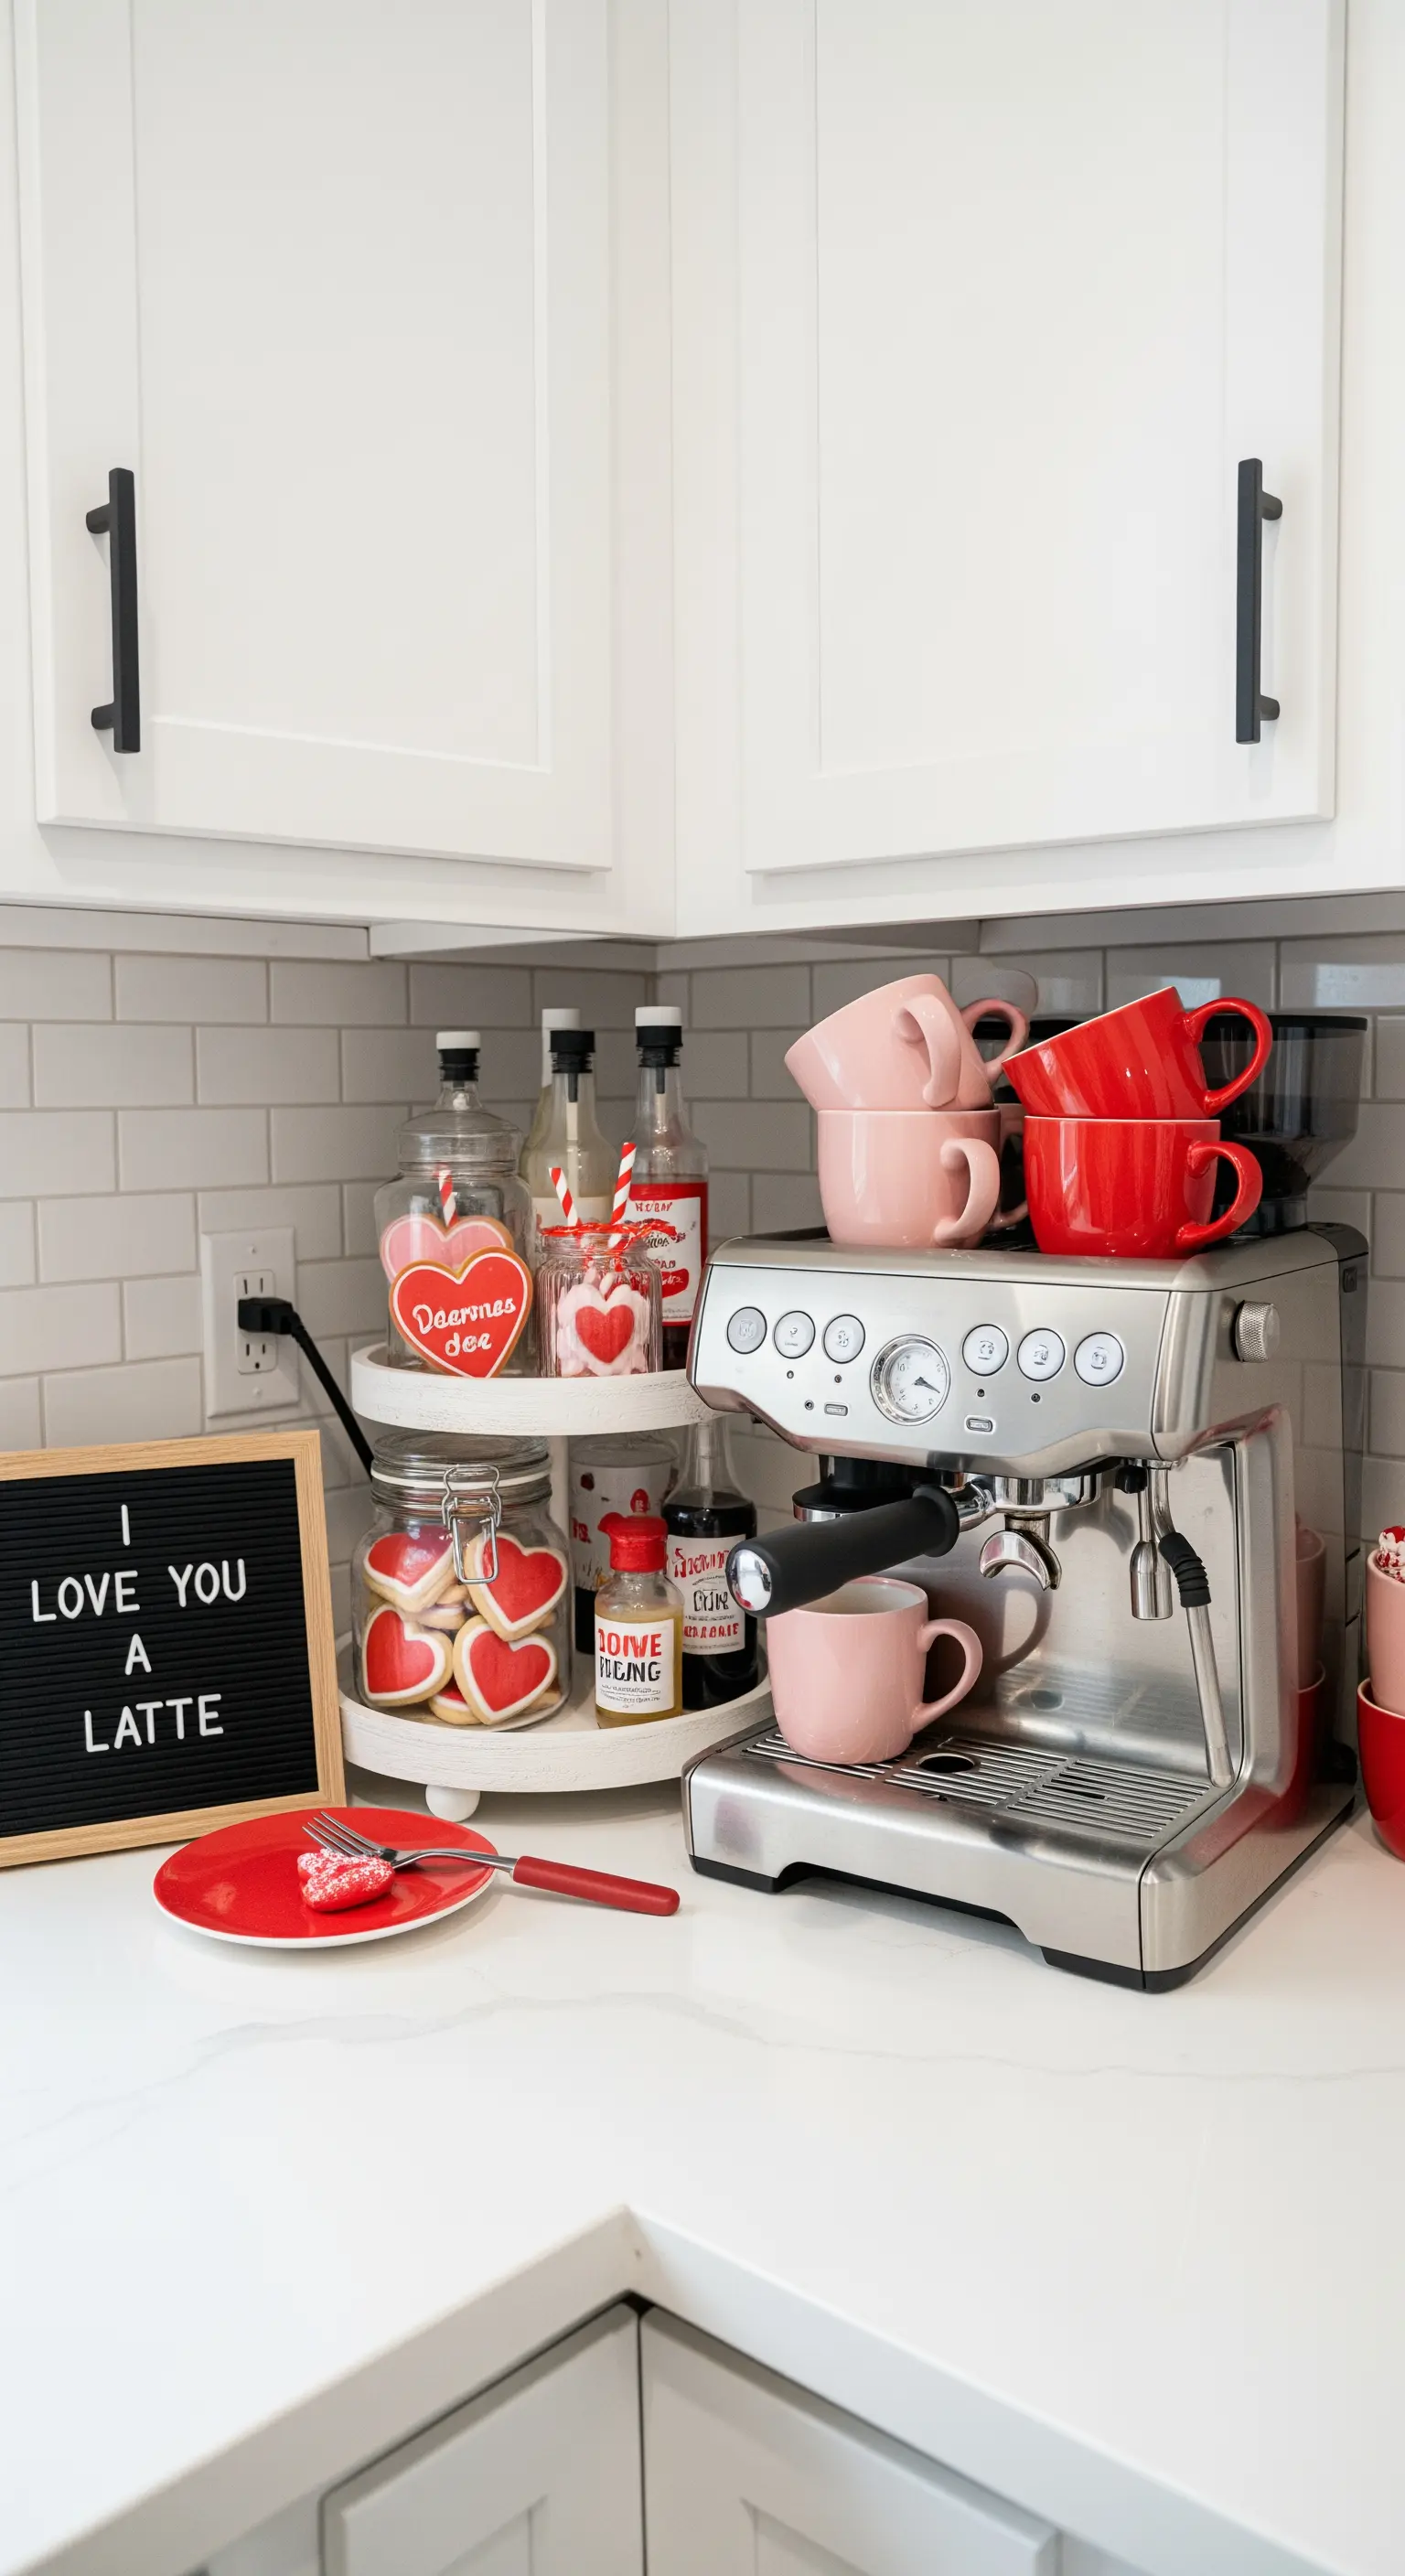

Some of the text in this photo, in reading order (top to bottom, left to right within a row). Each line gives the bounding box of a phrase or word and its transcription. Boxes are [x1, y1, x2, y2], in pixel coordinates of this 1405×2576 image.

[121, 1504, 131, 1546] I
[31, 1558, 247, 1623] LOVE YOU
[124, 1633, 152, 1676] A
[84, 1693, 224, 1753] LATTE
